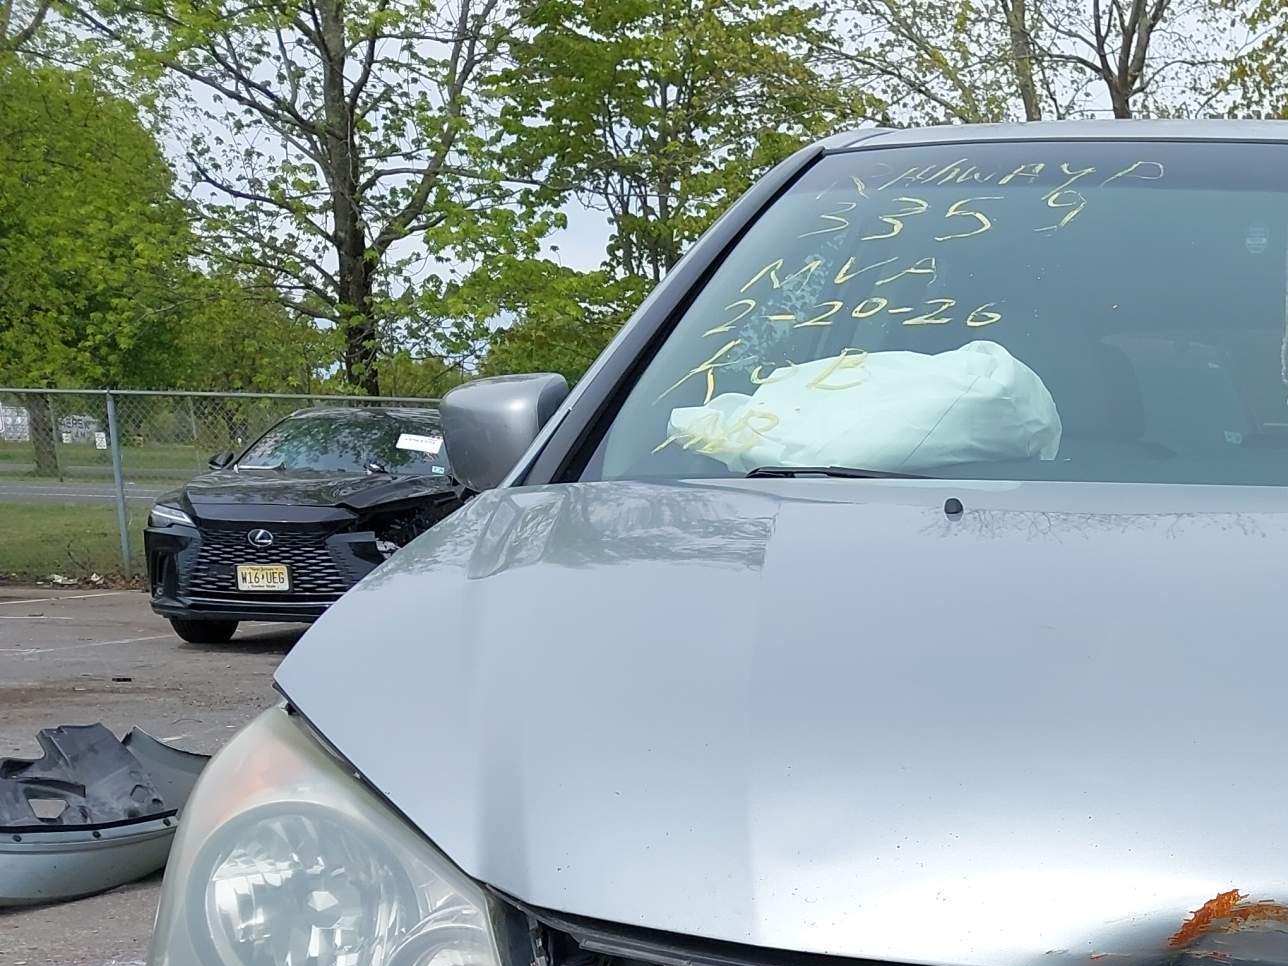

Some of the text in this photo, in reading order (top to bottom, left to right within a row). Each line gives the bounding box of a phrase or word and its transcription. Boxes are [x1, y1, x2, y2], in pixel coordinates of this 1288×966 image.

[798, 189, 1089, 242] 3359
[739, 256, 938, 294] MVA
[702, 297, 1003, 338] 2-20-26
